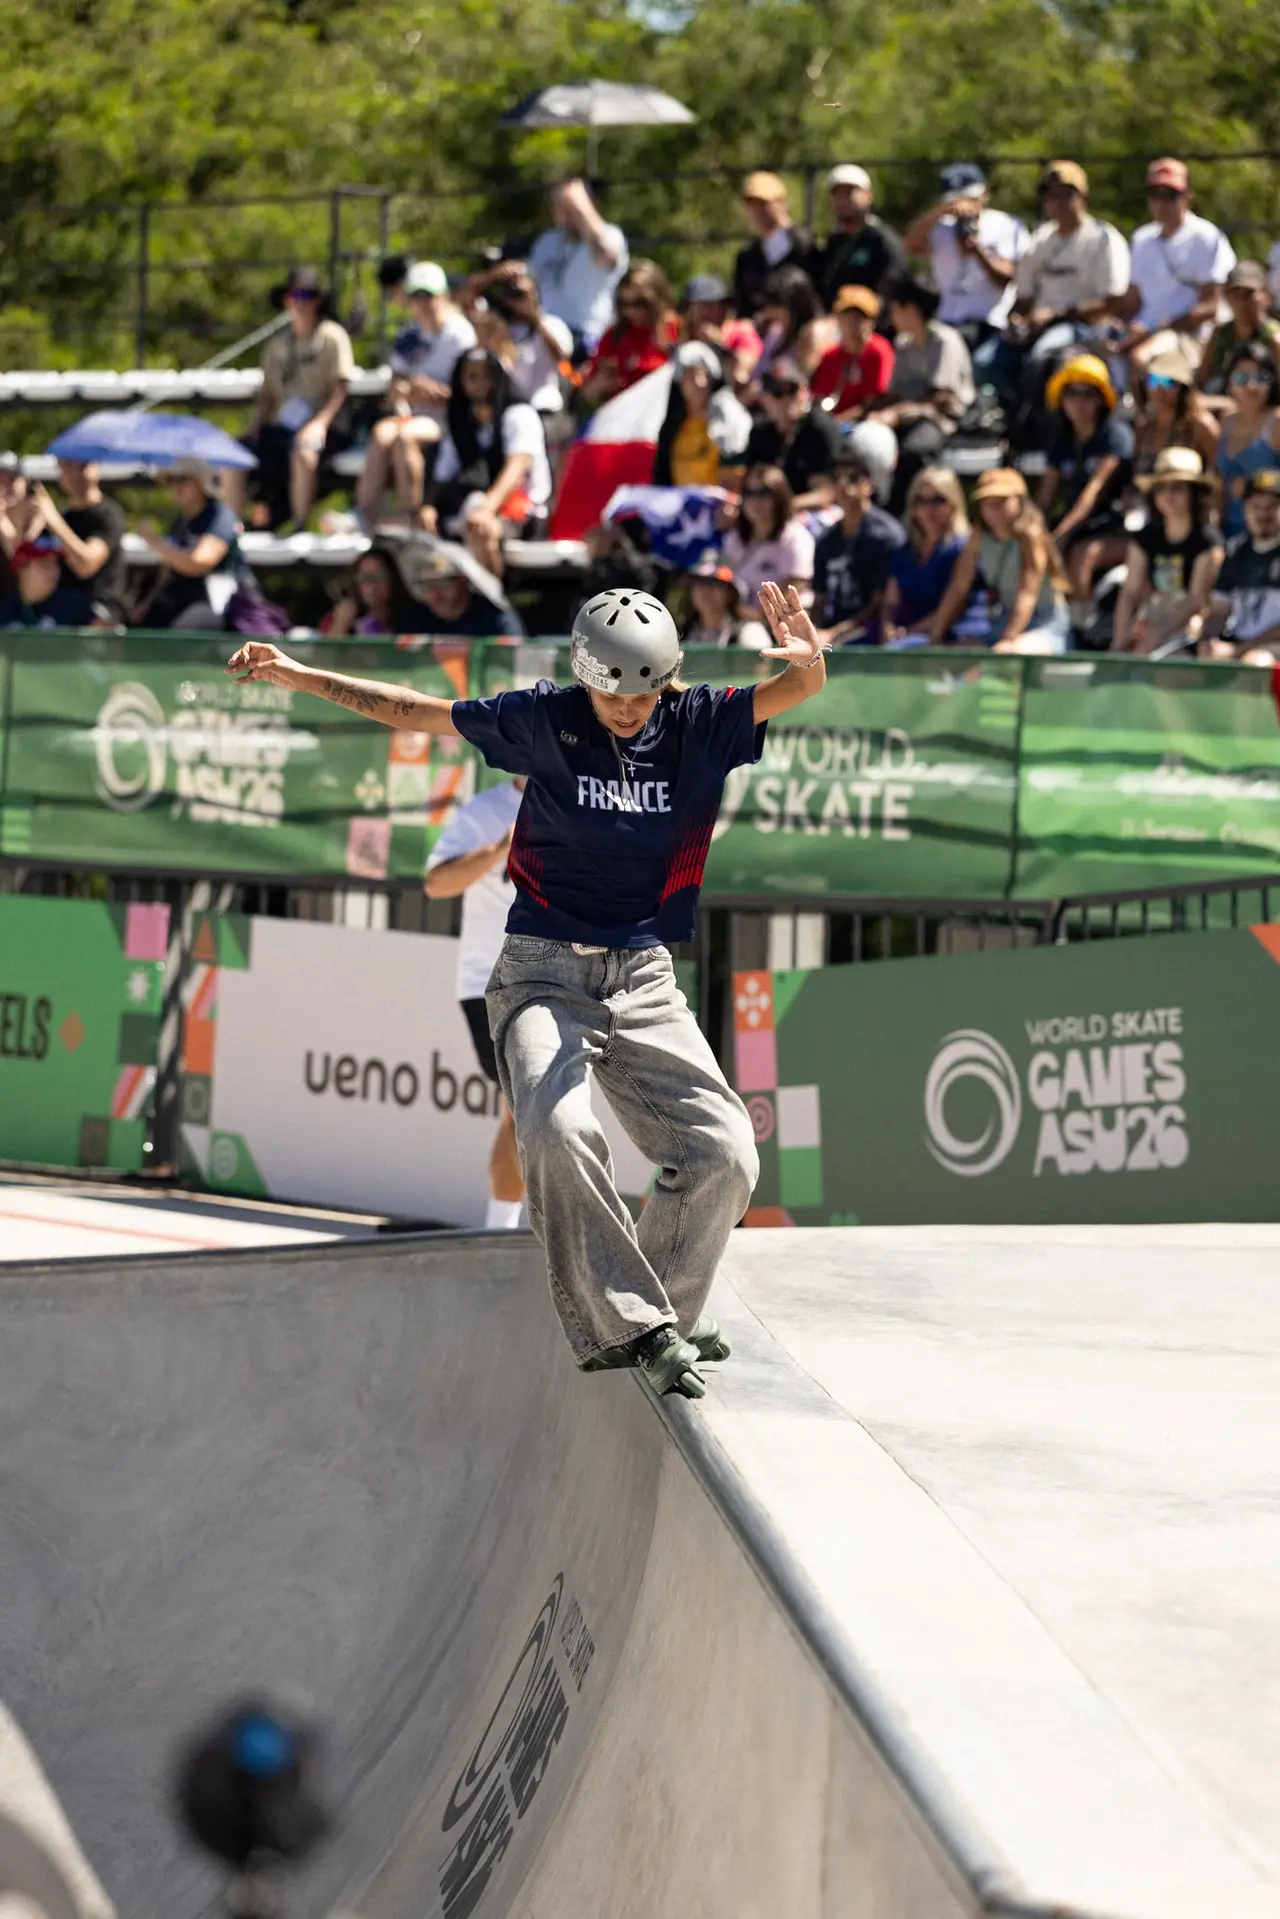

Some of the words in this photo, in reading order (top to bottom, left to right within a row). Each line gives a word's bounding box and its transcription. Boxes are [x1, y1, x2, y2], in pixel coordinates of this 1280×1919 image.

[764, 726, 915, 779] WORLD
[577, 775, 672, 813] FRANCE
[754, 777, 914, 841] SKATE
[1024, 1014, 1108, 1044] WORLD
[1111, 1006, 1183, 1038] SKATE
[304, 1050, 419, 1107] ueno
[1028, 1041, 1186, 1112] GAMES
[1033, 1104, 1189, 1177] ASU26
